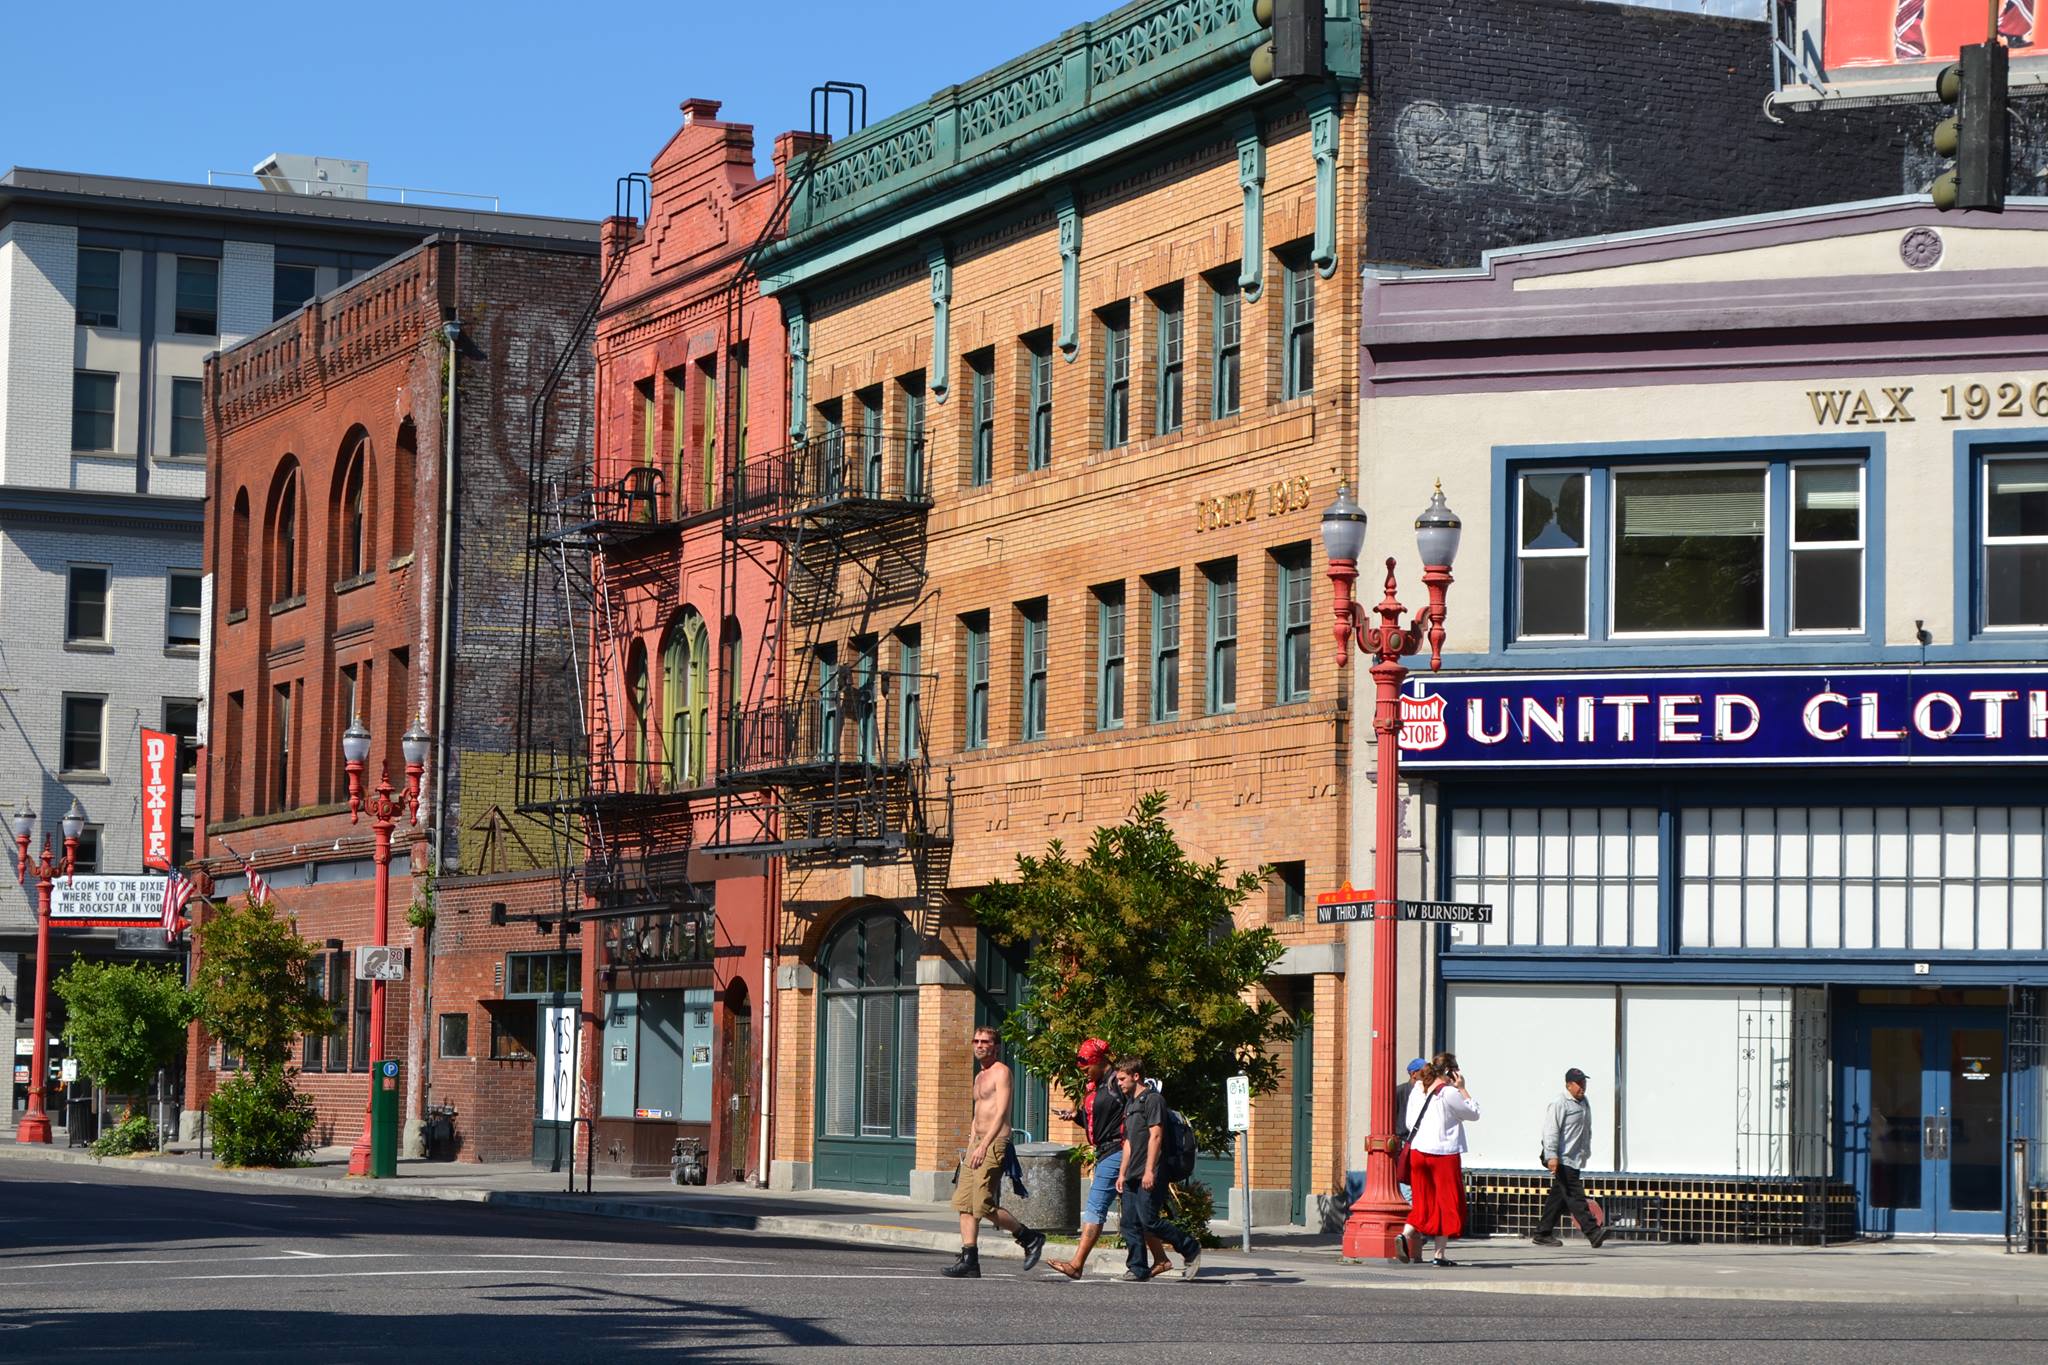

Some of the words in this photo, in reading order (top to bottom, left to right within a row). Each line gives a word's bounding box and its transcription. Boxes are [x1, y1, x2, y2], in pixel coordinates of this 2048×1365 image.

[1805, 387, 1916, 425] WAX
[1940, 382, 2048, 421] 1926
[1194, 487, 1257, 533] FRITZ
[1267, 475, 1311, 516] 1913
[1400, 700, 1440, 720] UNION
[1466, 693, 1761, 744] UNITED
[1399, 724, 1440, 744] STORE
[146, 737, 167, 856] DIXIE
[104, 881, 116, 891] TO
[120, 881, 136, 891] THE
[140, 881, 165, 891] DIXIE
[62, 892, 92, 902] WHERE
[95, 892, 114, 902] YOU
[118, 892, 136, 902] CAN
[141, 892, 161, 902] FIND
[58, 903, 75, 913] THE
[79, 903, 127, 913] ROCKSTAR
[132, 903, 141, 913] IN
[144, 903, 163, 913] YOU
[1319, 907, 1332, 922] NW
[1335, 904, 1358, 921] THIRD
[1360, 903, 1374, 919] AVE
[1406, 904, 1418, 919] W
[1420, 905, 1475, 921] BURNSIDE
[1478, 907, 1492, 922] ST
[390, 950, 403, 961] 90
[551, 1015, 571, 1055] YES
[552, 1069, 568, 1112] NO
